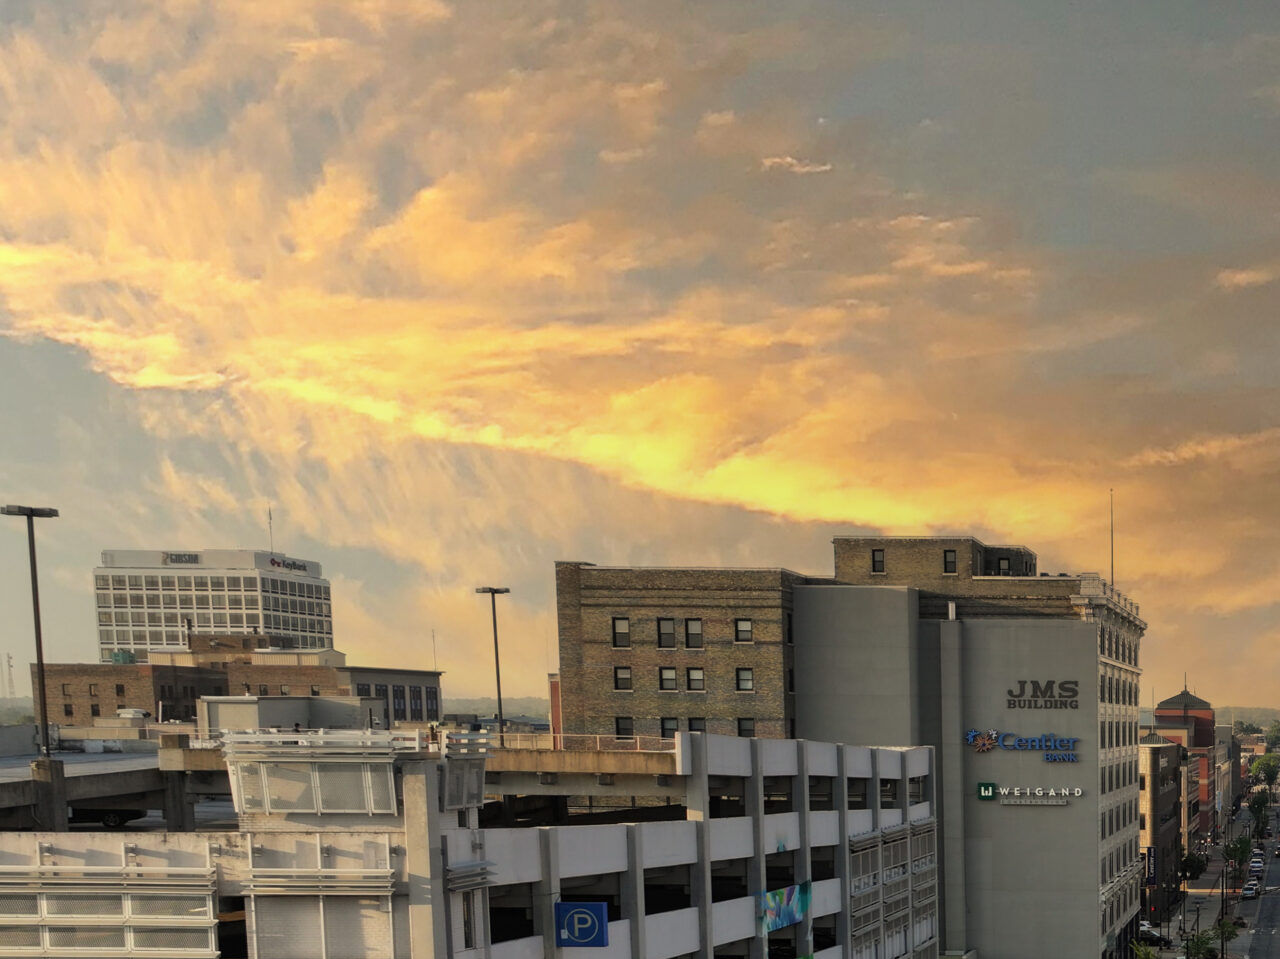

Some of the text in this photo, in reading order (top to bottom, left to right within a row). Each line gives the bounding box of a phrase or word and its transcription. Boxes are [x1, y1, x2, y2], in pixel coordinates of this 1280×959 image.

[281, 558, 307, 571] KeyBank
[1007, 680, 1079, 699] JMS
[1007, 699, 1079, 709] BUILDING
[998, 732, 1080, 751] Centier
[1043, 752, 1079, 763] BANK
[1000, 786, 1083, 797] WEIGAND
[573, 913, 592, 937] P
